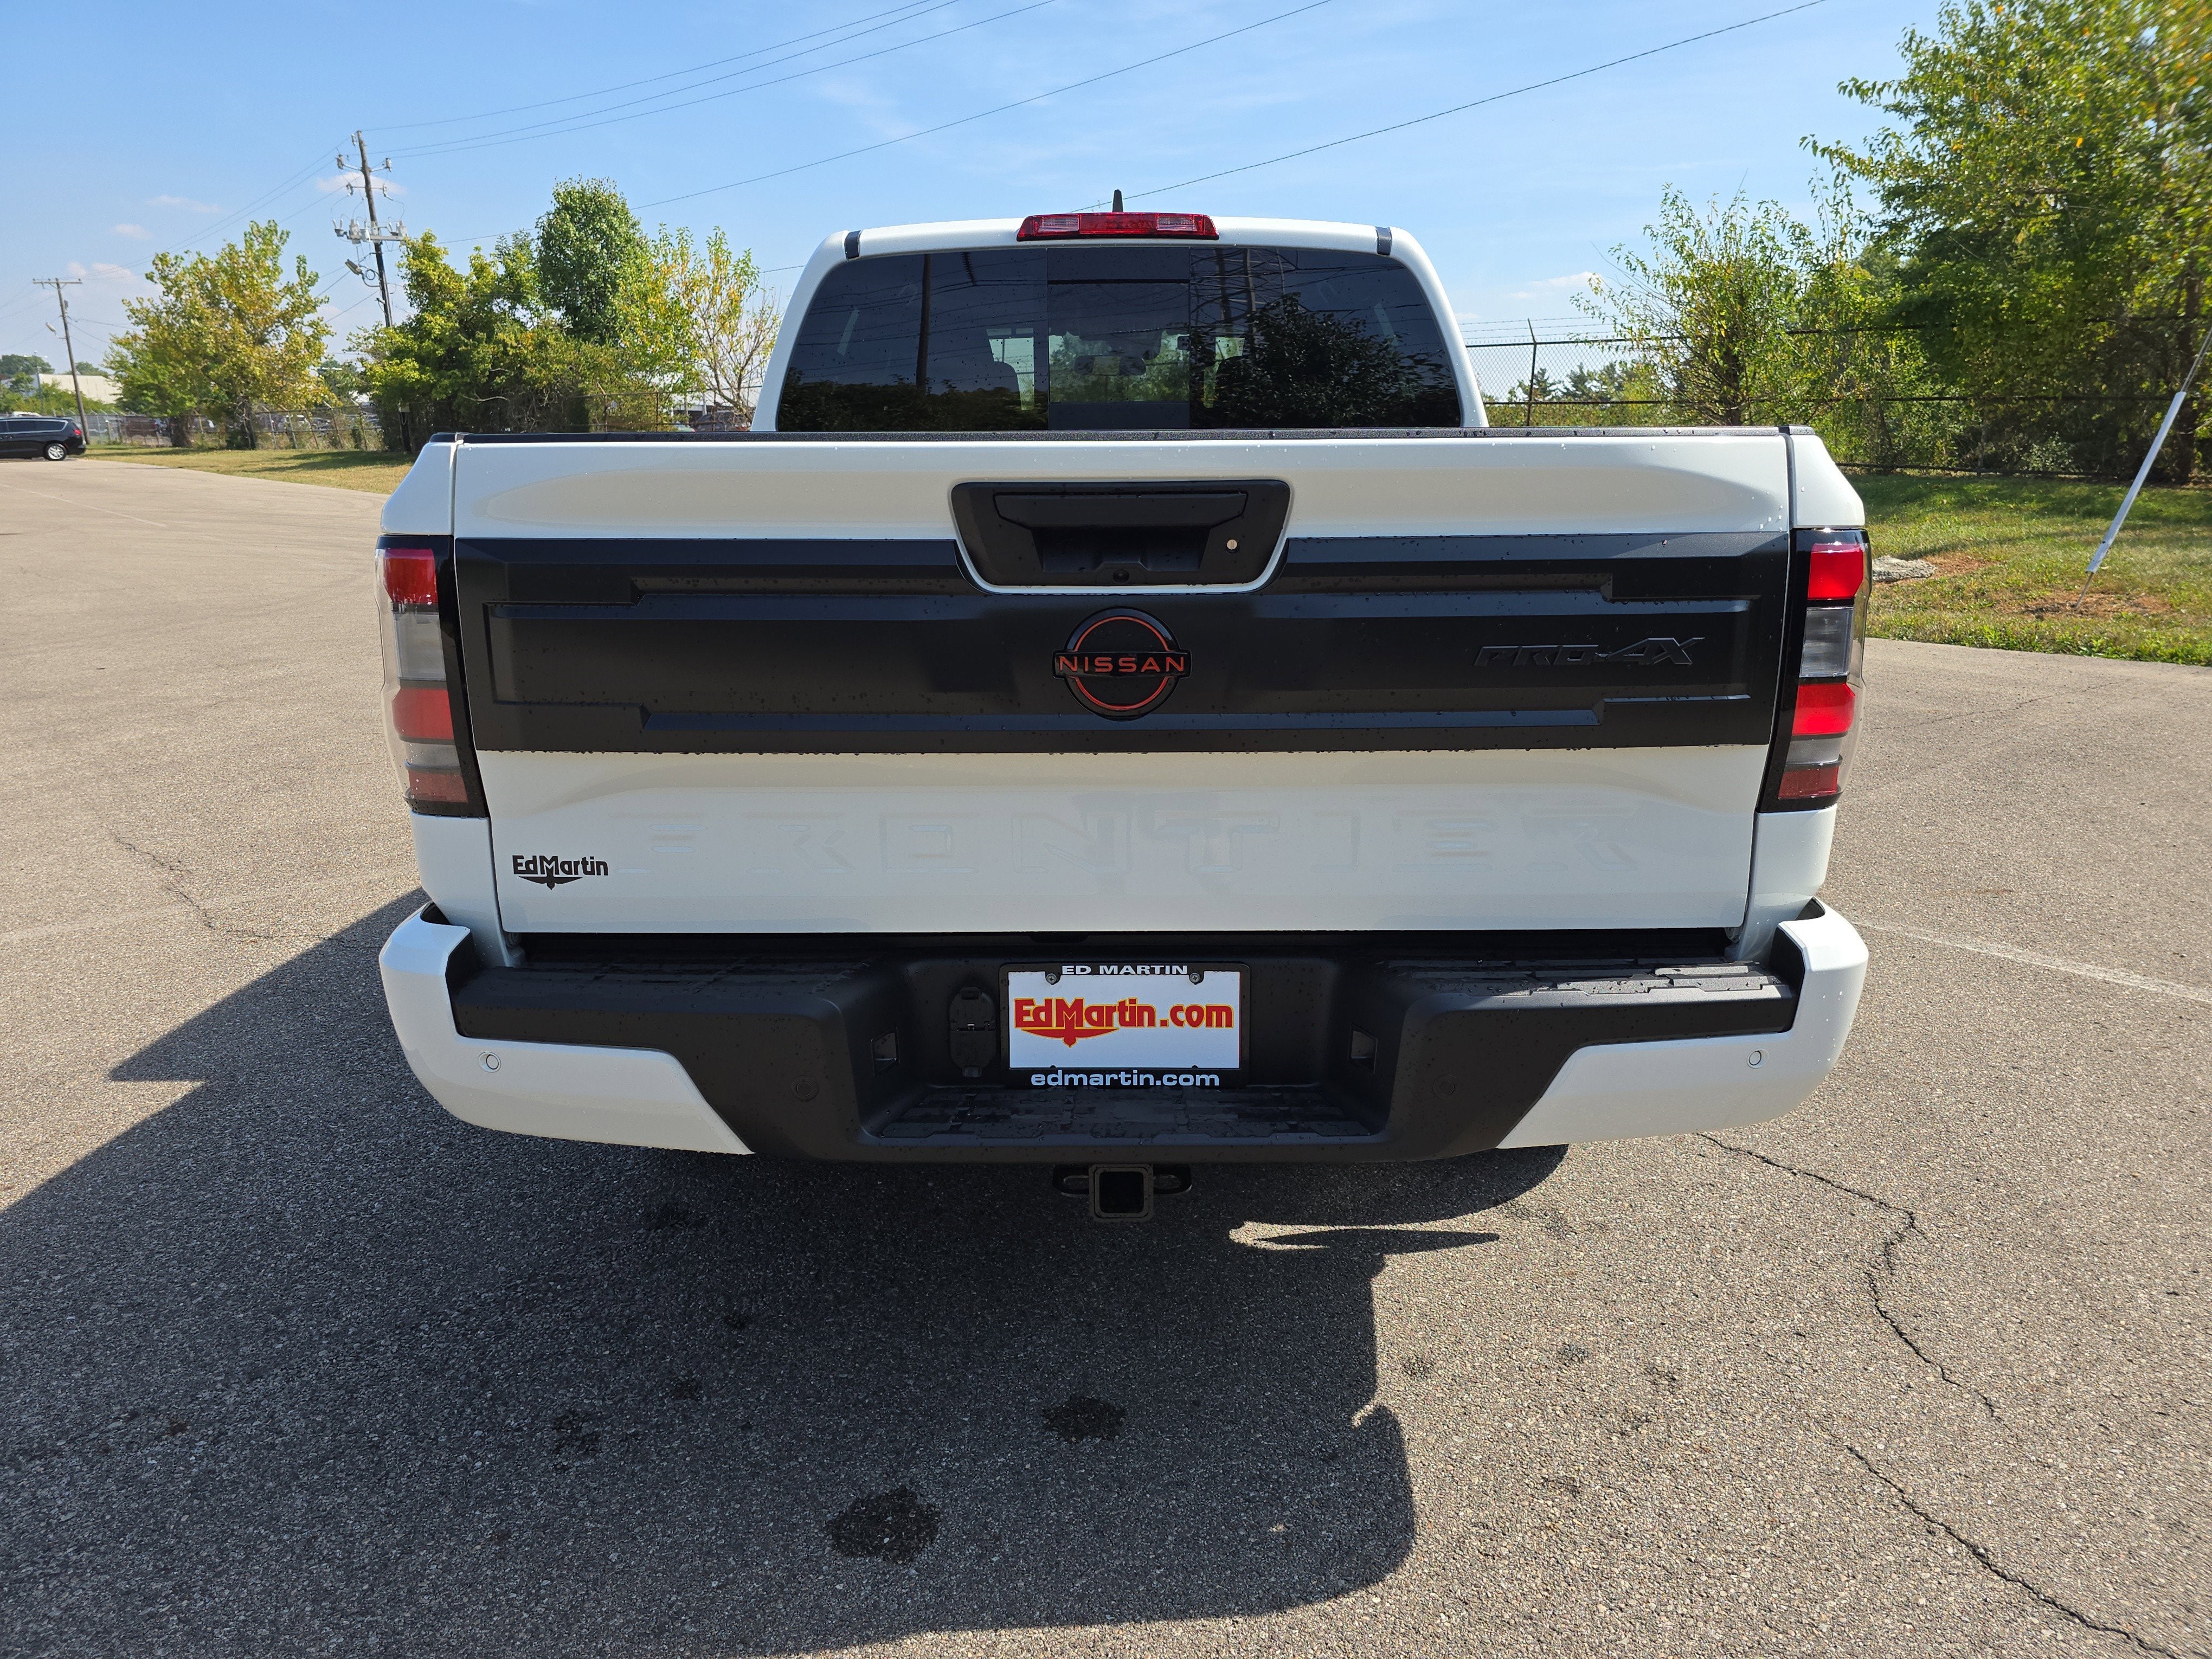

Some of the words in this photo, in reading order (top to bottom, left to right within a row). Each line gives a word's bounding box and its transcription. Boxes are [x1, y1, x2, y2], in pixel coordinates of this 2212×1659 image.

[1059, 655, 1185, 672] NISSAN
[607, 811, 1641, 876] FRONTIER
[1061, 965, 1092, 975] ED
[1099, 964, 1188, 975] MARTIN
[1031, 1069, 1220, 1086] edmartin.com
